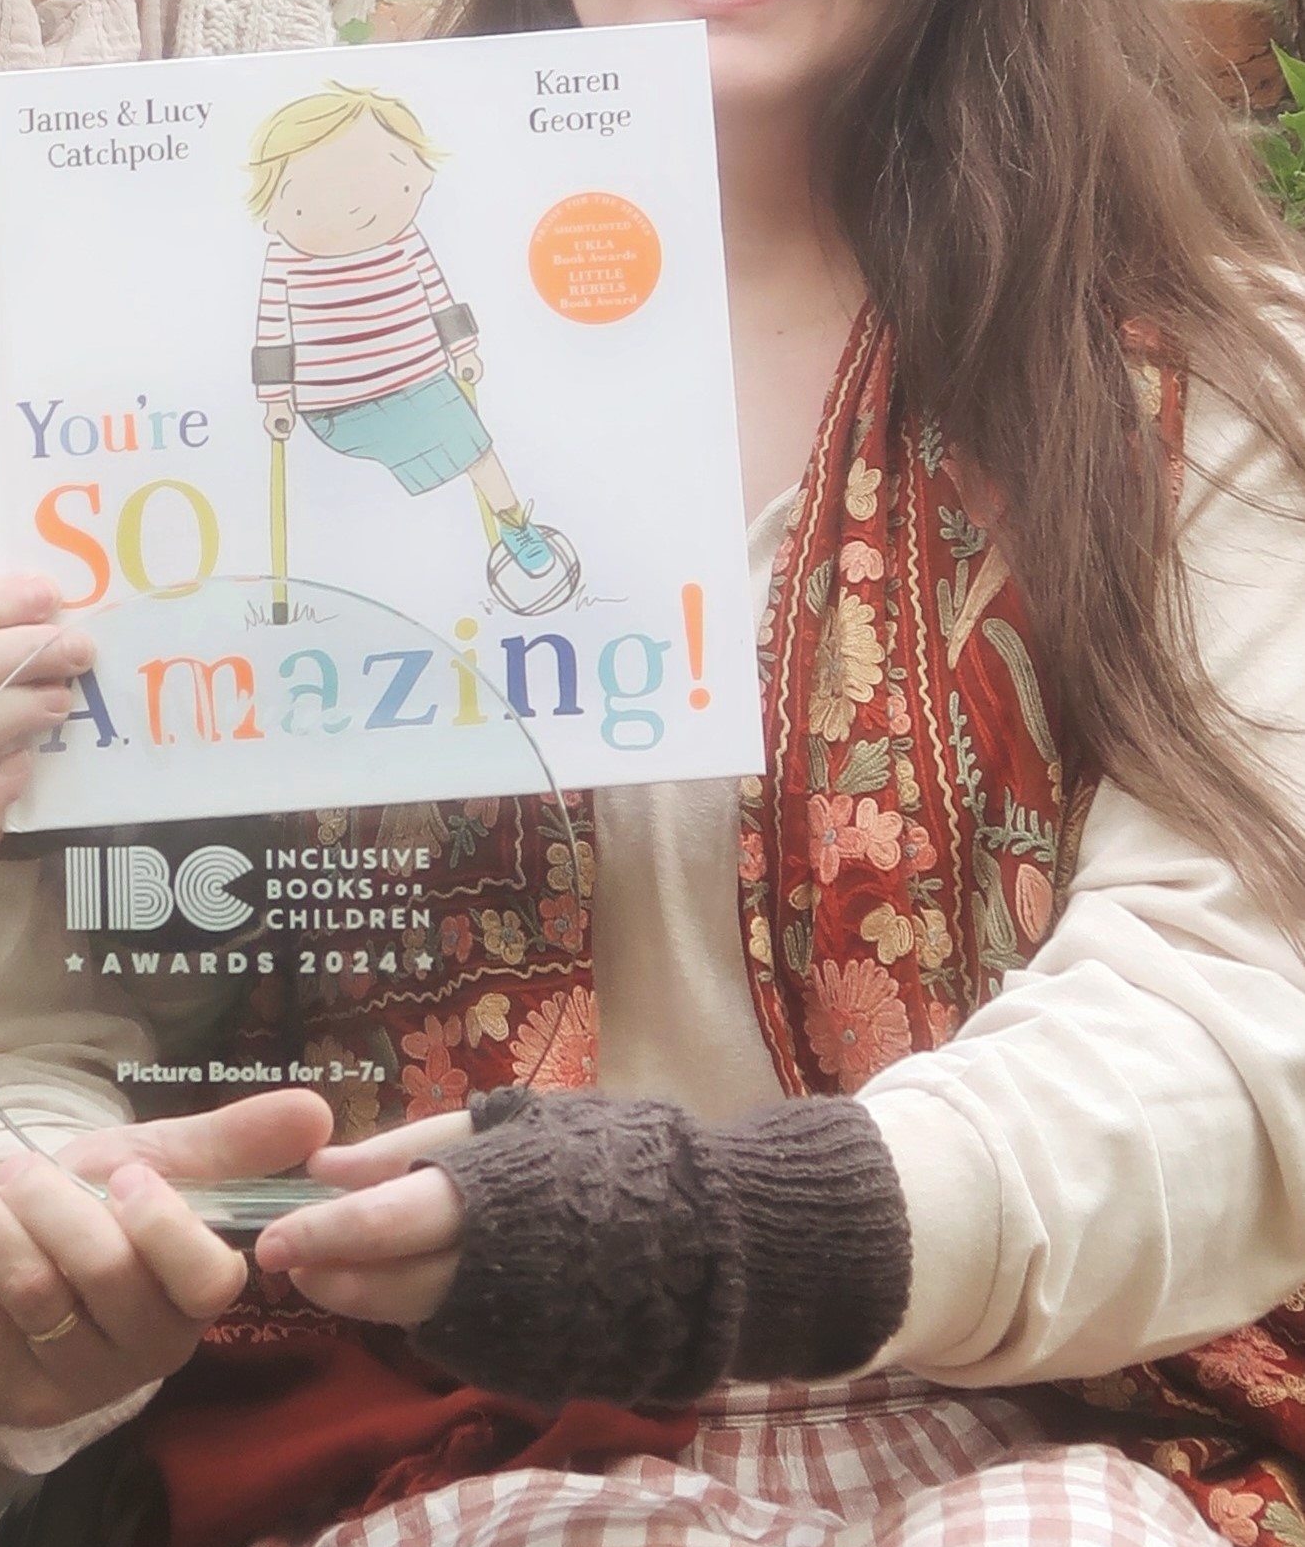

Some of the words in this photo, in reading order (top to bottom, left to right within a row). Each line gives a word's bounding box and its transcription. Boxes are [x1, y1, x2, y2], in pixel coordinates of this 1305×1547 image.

[534, 67, 620, 96] Karen
[18, 102, 108, 135] James
[117, 101, 137, 126] &
[145, 99, 213, 130] Lucy
[528, 105, 632, 137] George
[47, 136, 190, 169] Catchpole
[553, 254, 585, 265] Book
[590, 251, 637, 262] Awards
[569, 268, 623, 282] LITTLE
[569, 282, 626, 295] REBELS
[560, 298, 592, 308] Book
[597, 294, 637, 306] Award
[17, 395, 209, 459] You're
[34, 479, 219, 610] SO
[39, 583, 713, 753] Amazing!
[266, 848, 431, 870] INCLUSIVE
[65, 845, 254, 932] IBC
[266, 879, 372, 900] BOOKS
[381, 884, 423, 896] FOR
[266, 909, 431, 930] CHILDREN
[101, 953, 274, 974] AWARDS
[299, 952, 397, 973] 2024
[117, 1062, 202, 1083] Picture
[208, 1062, 282, 1083] Books
[289, 1061, 323, 1083] for
